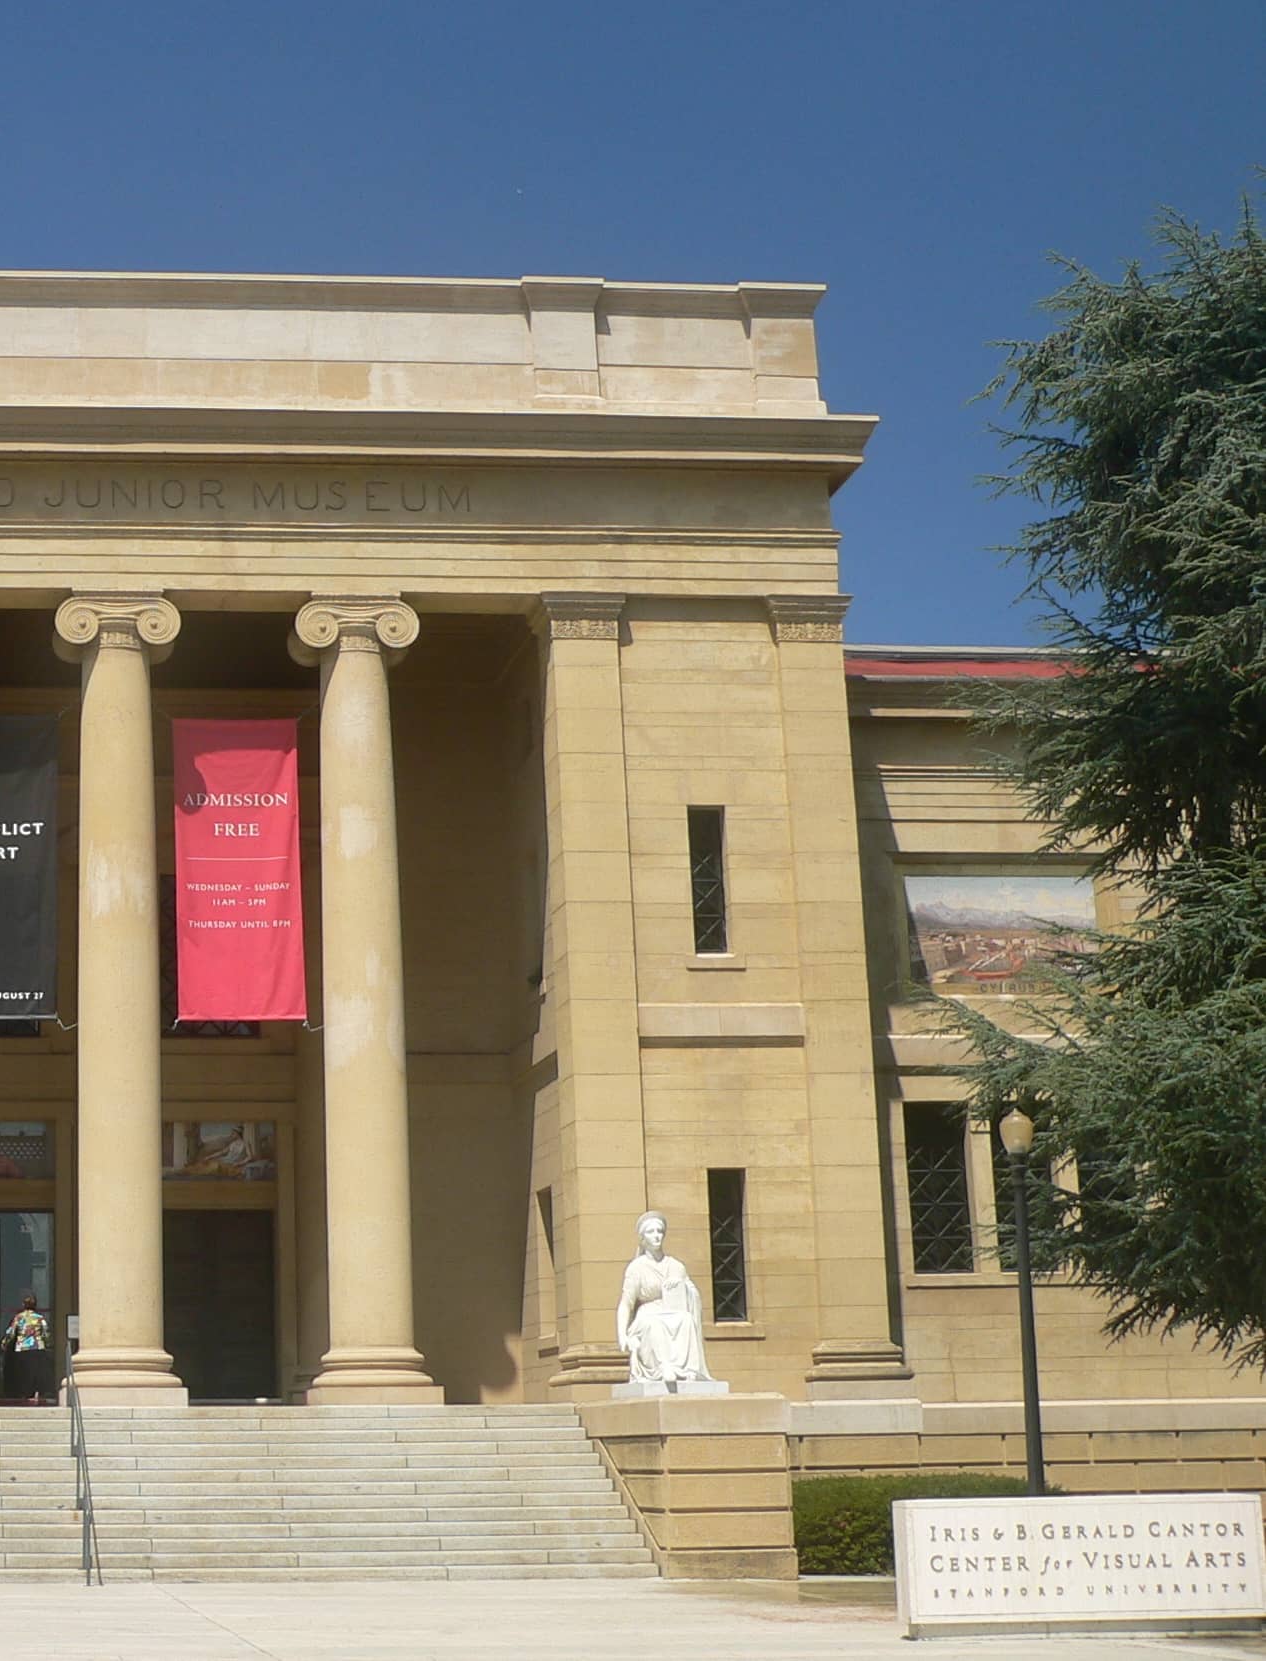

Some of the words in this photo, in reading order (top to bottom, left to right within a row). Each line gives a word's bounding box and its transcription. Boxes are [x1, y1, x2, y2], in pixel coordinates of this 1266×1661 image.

[44, 479, 225, 510] JUNIOR
[252, 480, 471, 513] MUSEUM
[184, 792, 288, 807] ADMISSION
[214, 823, 260, 837] FREE
[187, 884, 242, 892] WEDNESDAY
[255, 883, 290, 892] SUNDAY
[213, 899, 236, 907] 11AM
[248, 899, 267, 907] 5PM
[189, 920, 237, 929] THURSDAY
[241, 920, 269, 929] UNTIL
[930, 1526, 980, 1542] IRIS
[993, 1528, 1004, 1541] &
[1041, 1522, 1134, 1540] GERALD
[1148, 1521, 1244, 1538] CANTOR
[930, 1555, 1030, 1573] CENTER
[1040, 1555, 1073, 1576] for
[1082, 1552, 1172, 1569] VISUAL
[1186, 1550, 1247, 1568] ARTS
[934, 1586, 1064, 1599] STANFORD
[1086, 1583, 1247, 1595] UNIVERSITY
